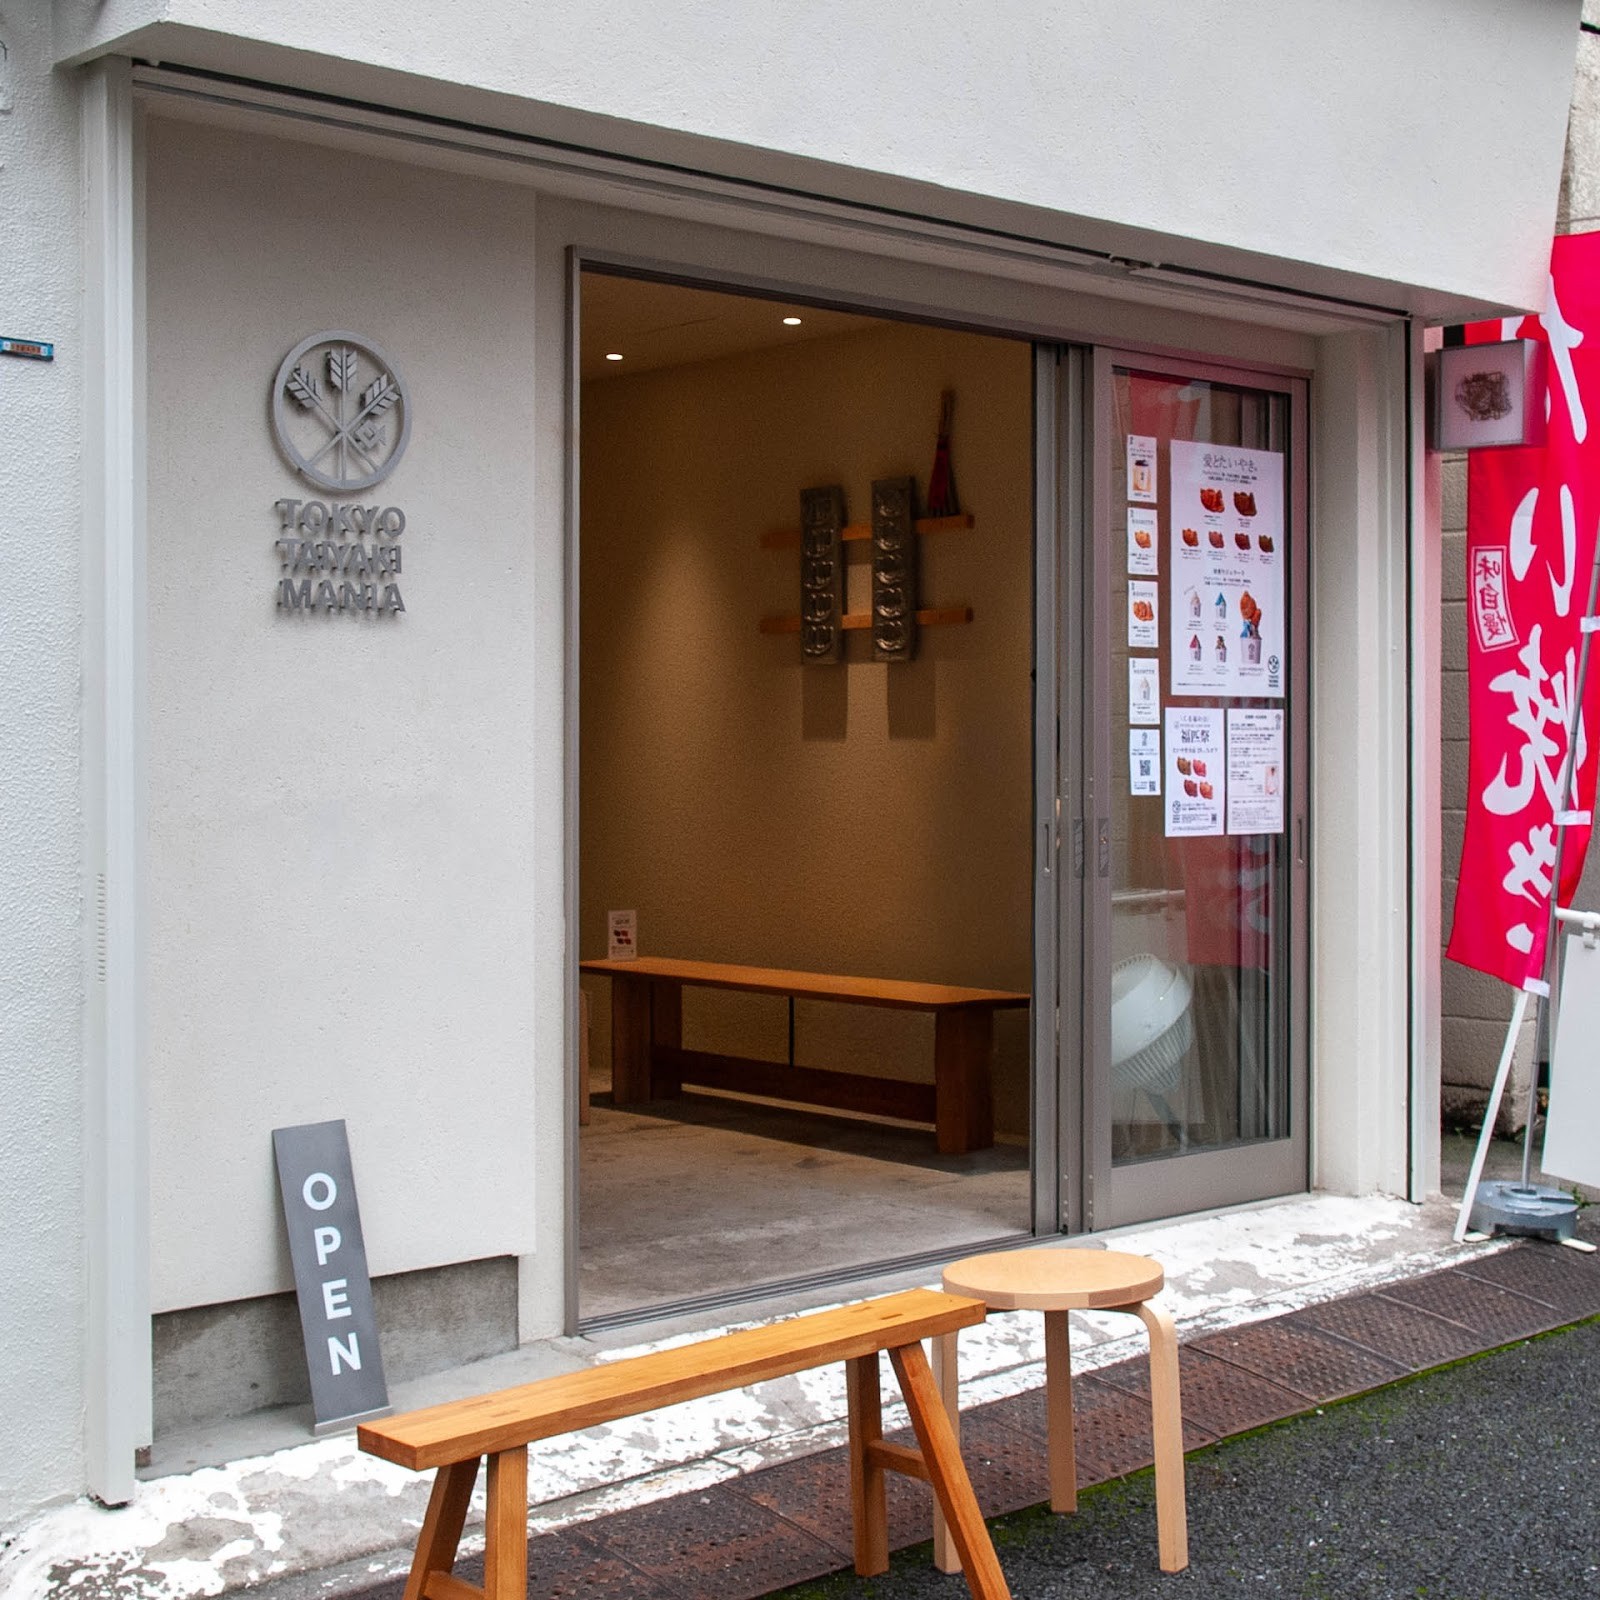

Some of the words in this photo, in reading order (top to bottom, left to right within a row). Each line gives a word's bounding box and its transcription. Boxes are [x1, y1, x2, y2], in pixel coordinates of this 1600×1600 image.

[279, 498, 406, 538] TOKYO
[279, 538, 402, 574] TAIYAKI
[280, 578, 406, 613] MANIA
[302, 1171, 362, 1376] OPEN
